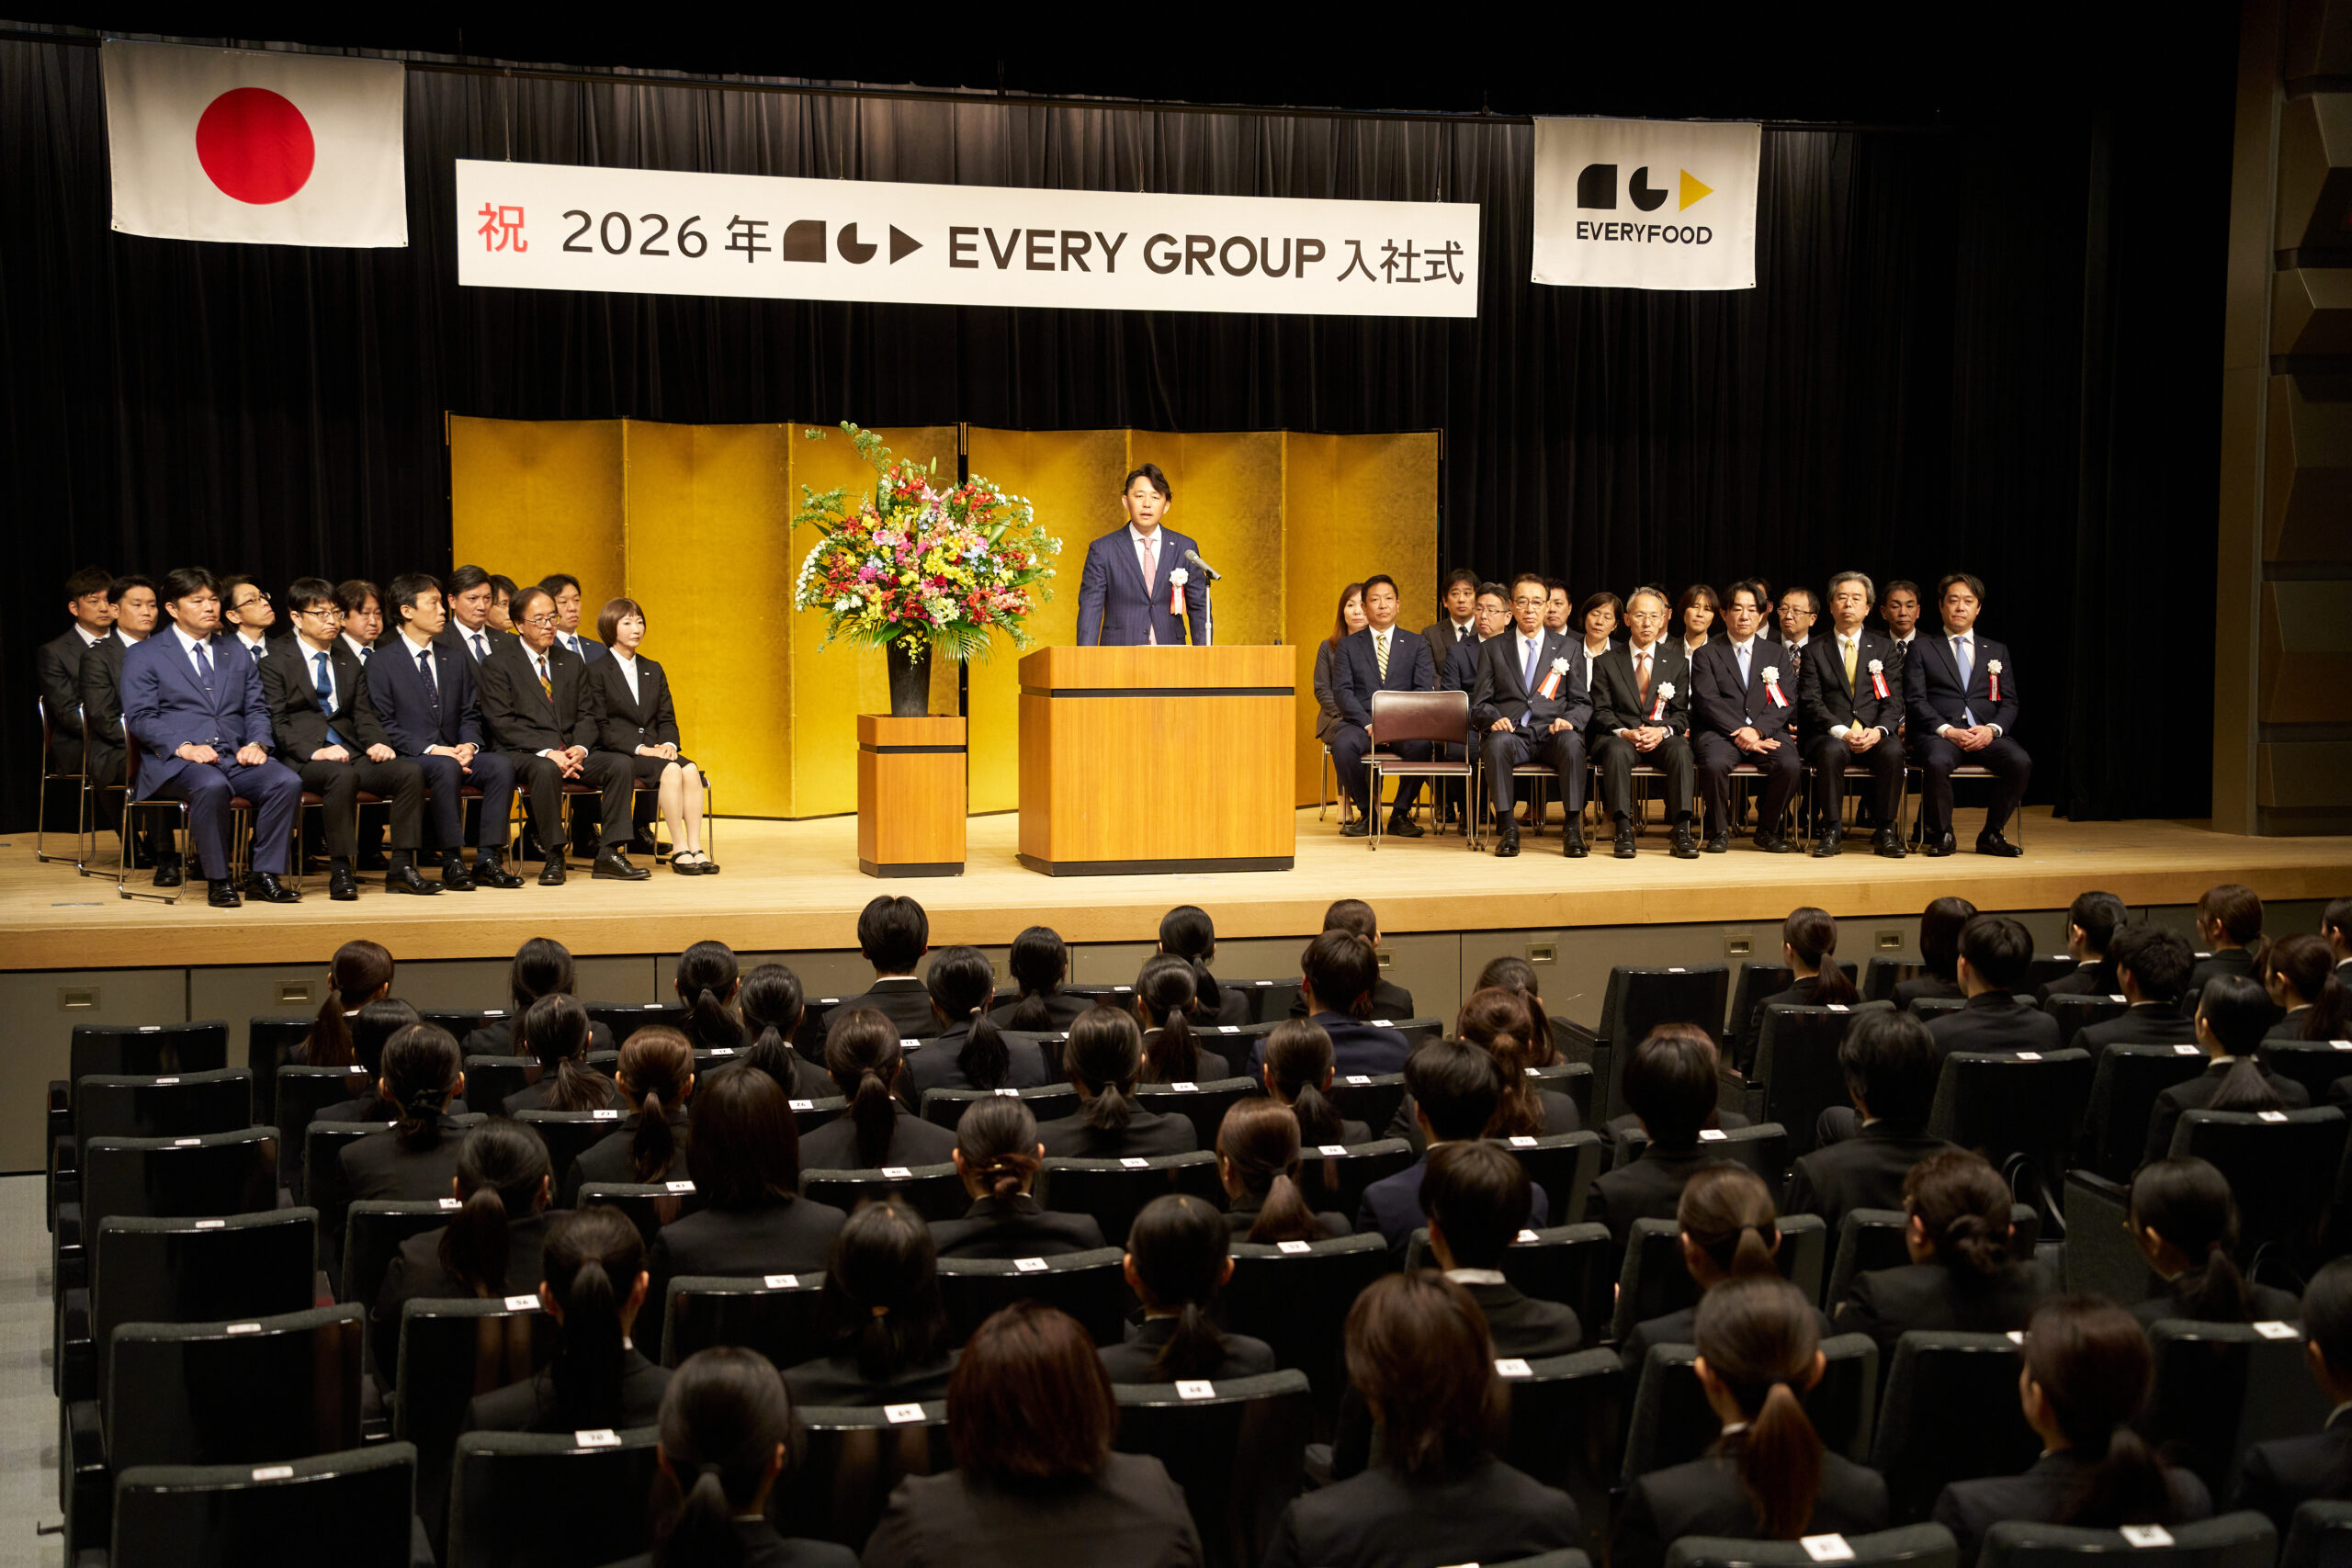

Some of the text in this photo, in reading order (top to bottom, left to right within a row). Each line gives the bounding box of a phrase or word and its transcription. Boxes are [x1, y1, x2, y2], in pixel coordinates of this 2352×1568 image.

[478, 203, 1464, 285] 祝 2026 年 EVERY GROUP 入社式
[1577, 221, 1713, 244] EVERYFOOD
